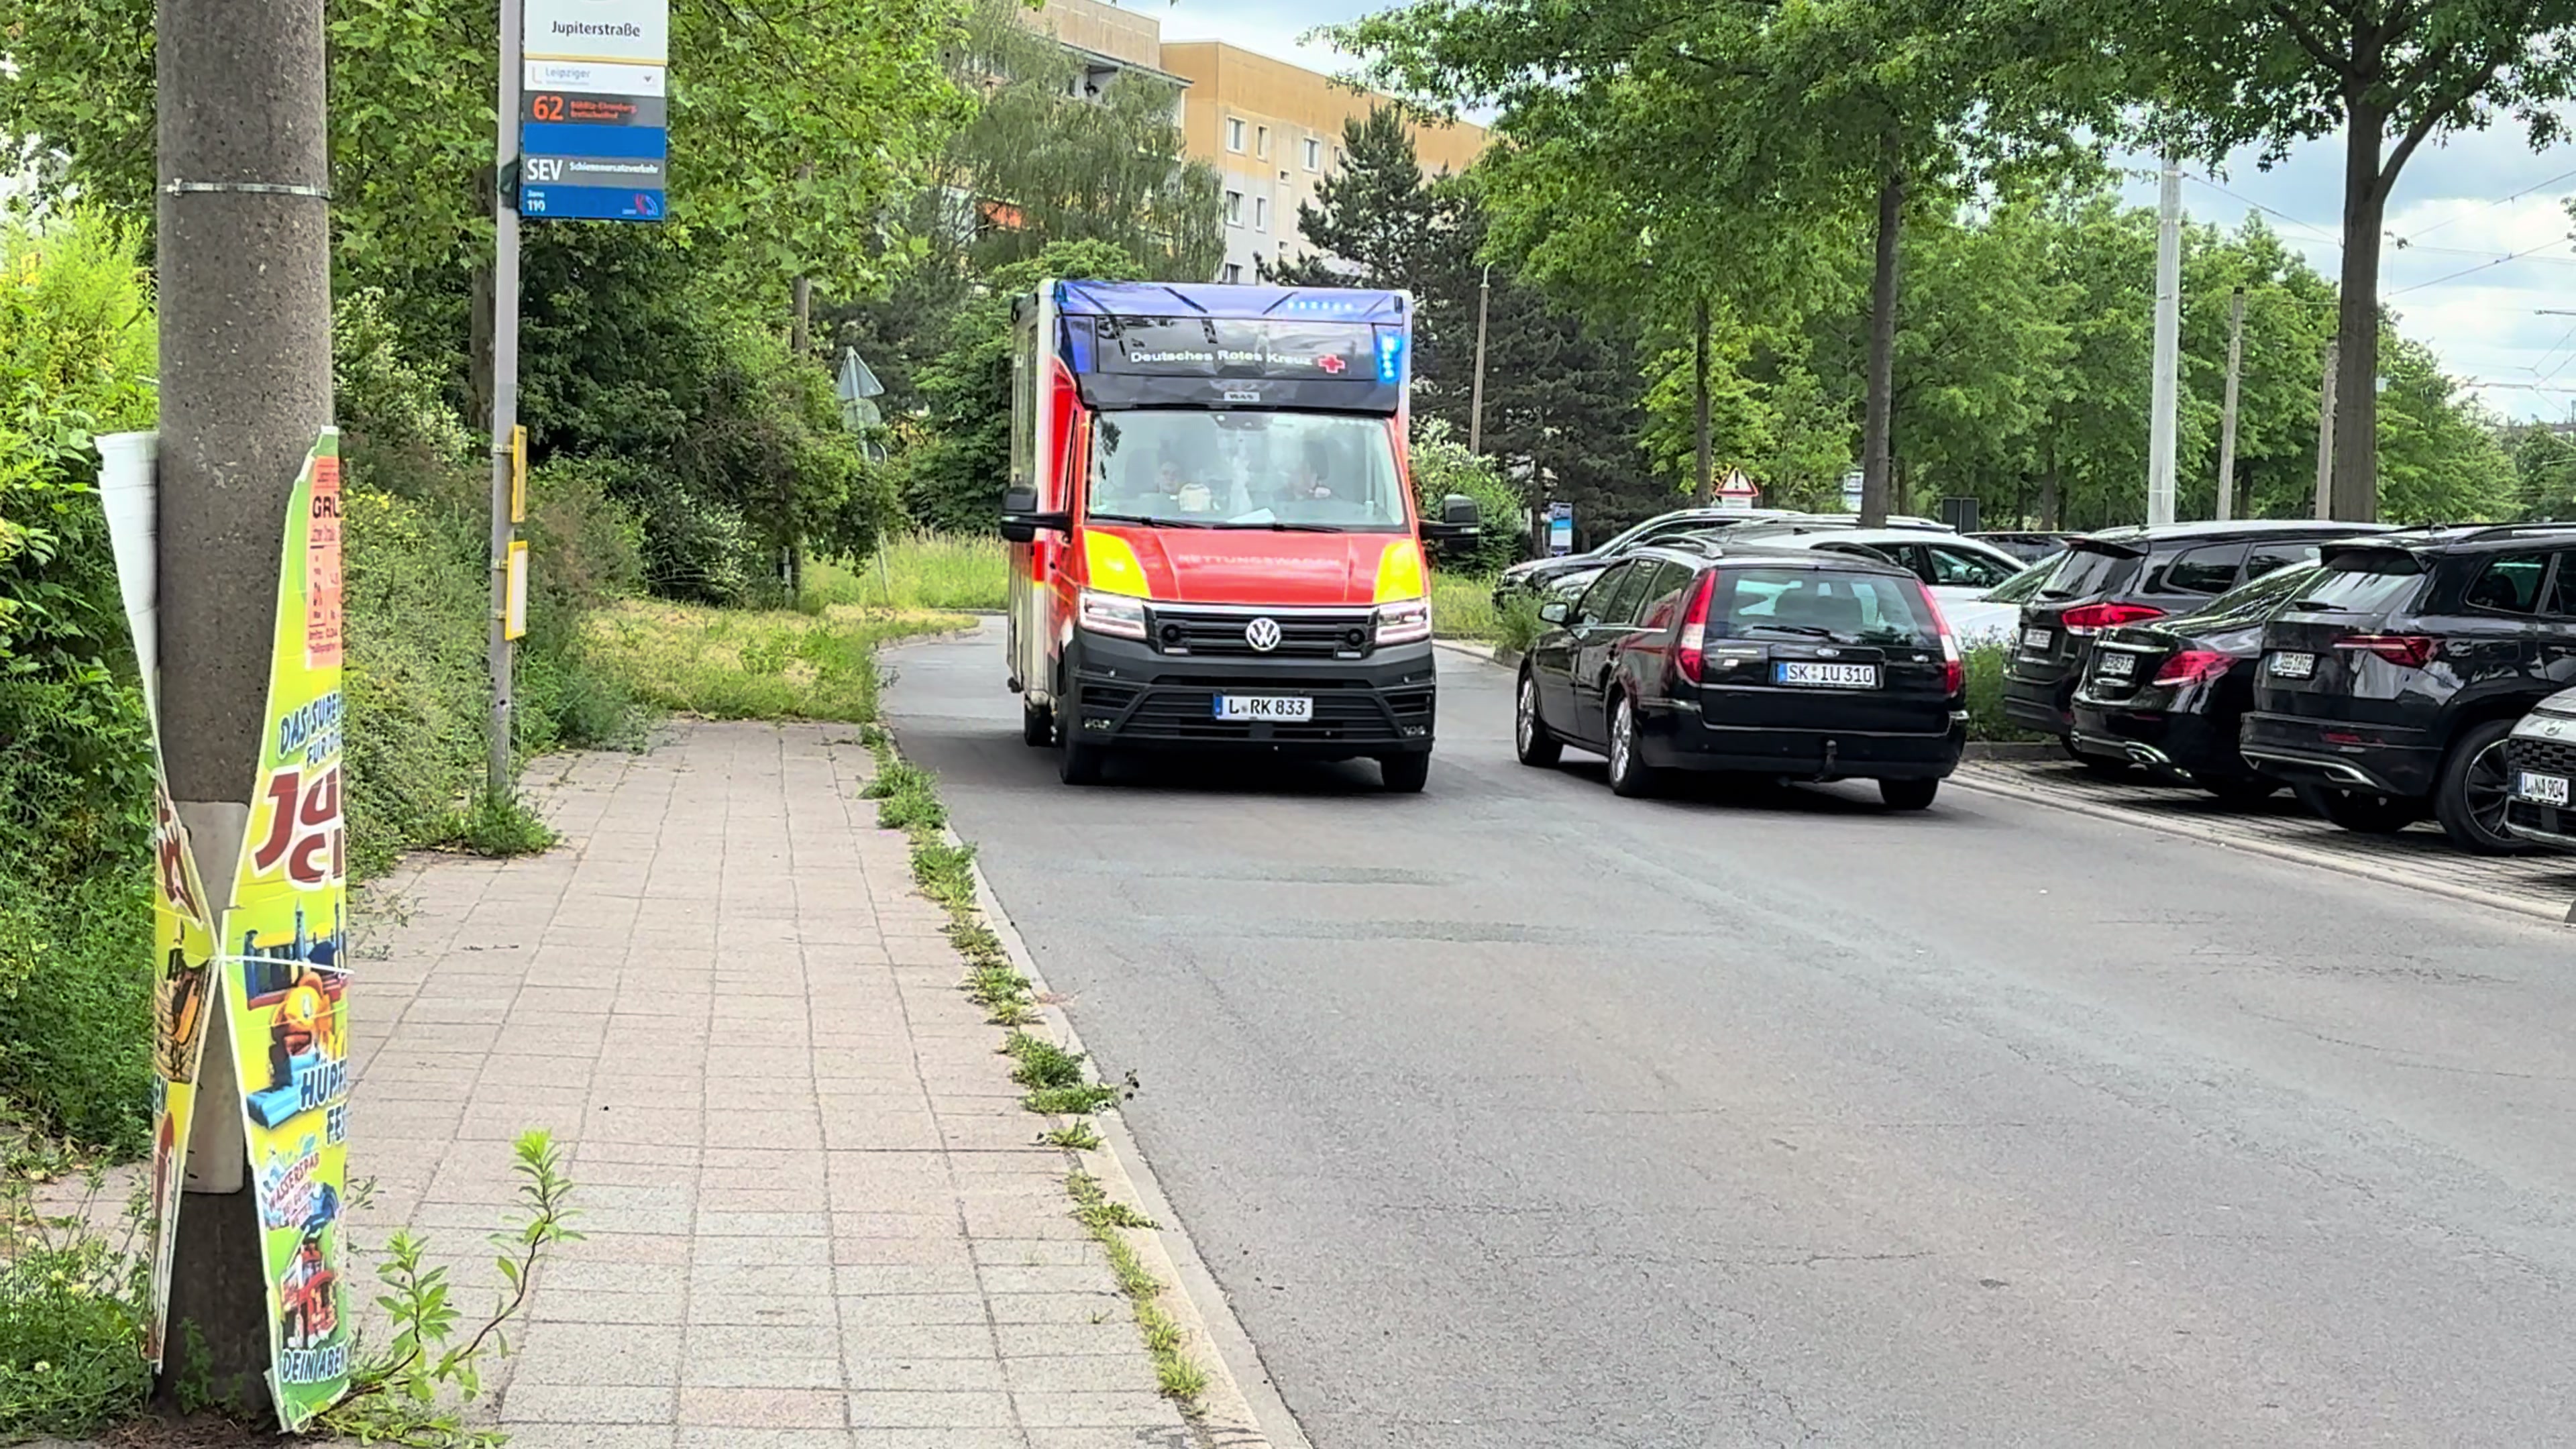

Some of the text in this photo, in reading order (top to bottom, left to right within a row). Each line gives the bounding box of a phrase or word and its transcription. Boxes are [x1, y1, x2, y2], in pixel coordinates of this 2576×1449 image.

[551, 20, 640, 37] Jupiterstraße
[545, 67, 590, 80] Leipziger
[533, 95, 564, 121] 62
[527, 158, 563, 181] SEV
[1130, 350, 1313, 366] Deutsches Rotes Kreuz
[1275, 700, 1305, 716] 833
[280, 706, 307, 755] DAS
[282, 1350, 315, 1381] DEIN
